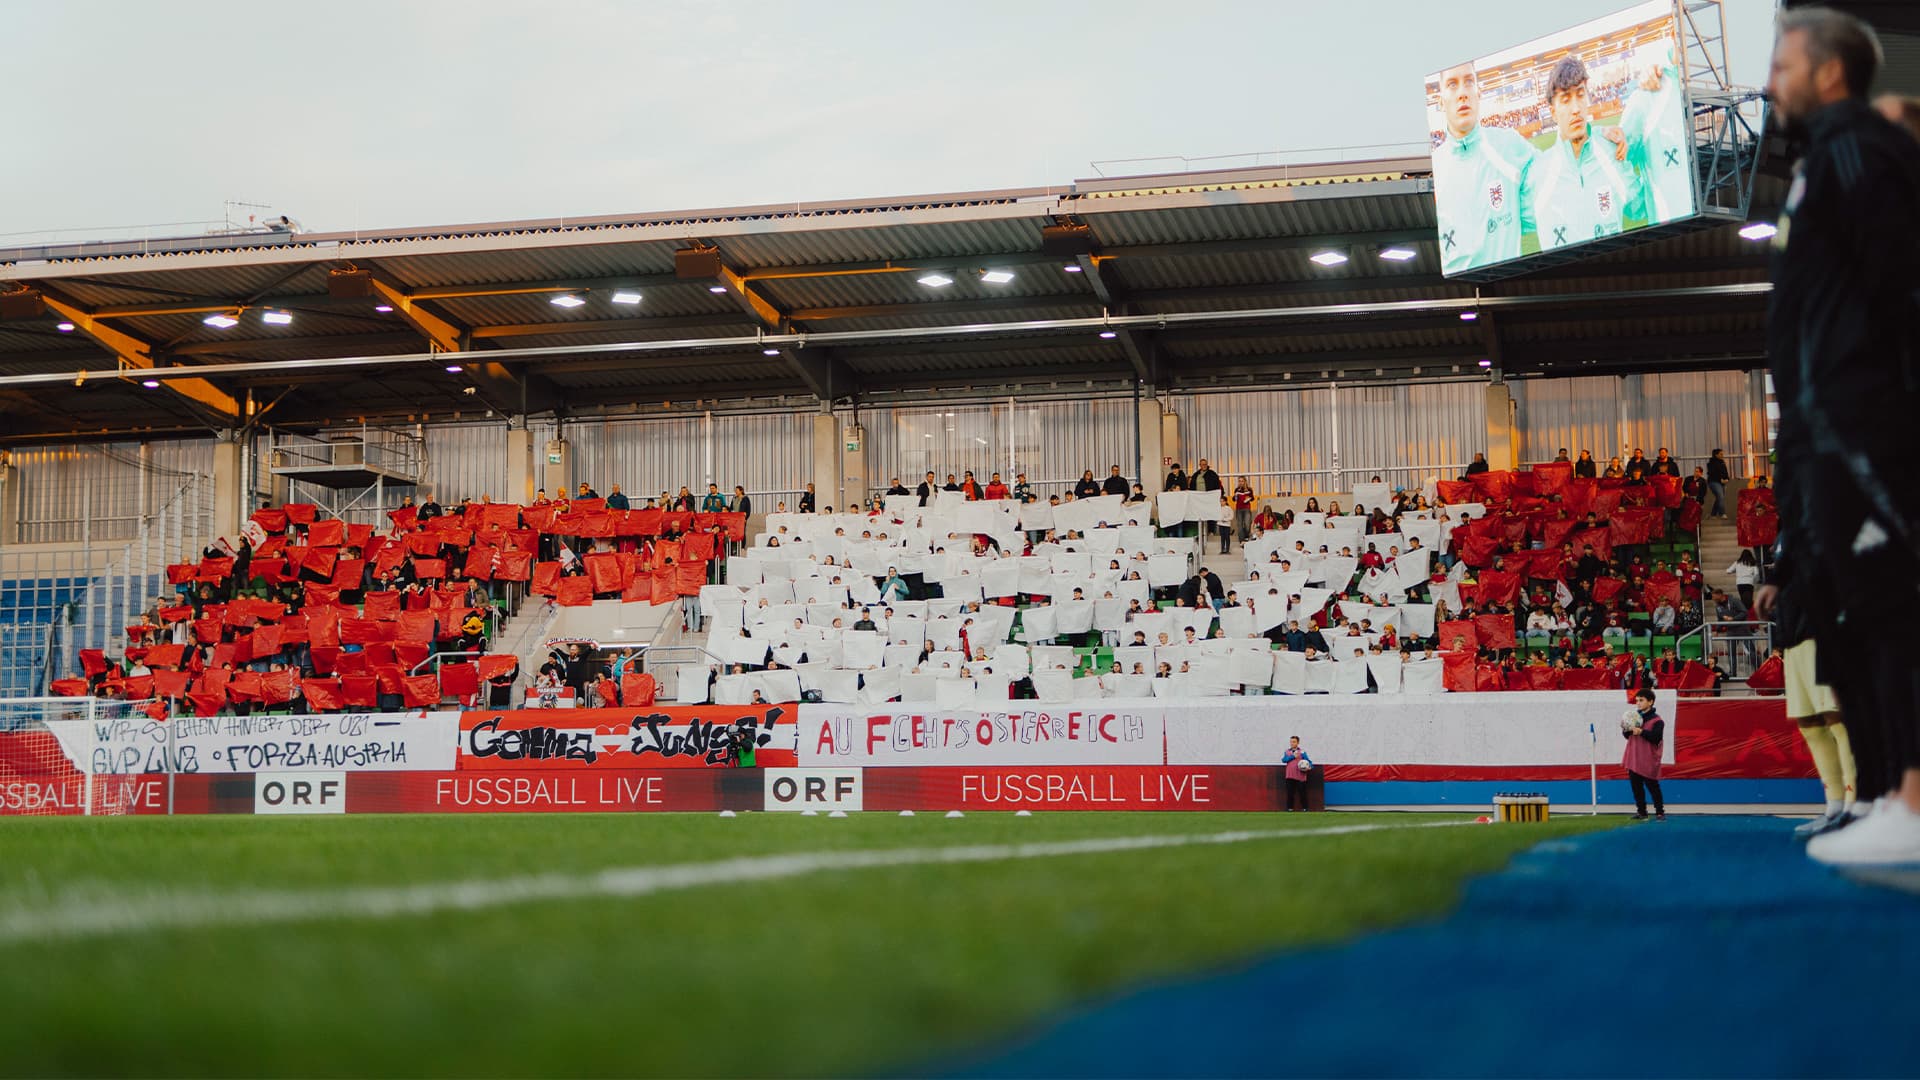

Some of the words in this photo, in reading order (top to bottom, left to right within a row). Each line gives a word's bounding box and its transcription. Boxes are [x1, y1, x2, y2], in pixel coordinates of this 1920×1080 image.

[95, 721, 137, 742] WIR
[287, 719, 331, 736] DER
[976, 711, 1144, 746] ÖSTERREICH
[227, 742, 318, 771] FORZA
[321, 741, 407, 768] AUSTRIA
[0, 783, 86, 808] SBALL
[103, 782, 162, 807] LIVE
[263, 781, 339, 805] ORF
[437, 778, 586, 805] FUSSBALL
[600, 777, 663, 804] LIVE
[773, 777, 855, 802] ORF
[962, 774, 1126, 802] FUSSBALL
[1140, 774, 1210, 802] LIVE
